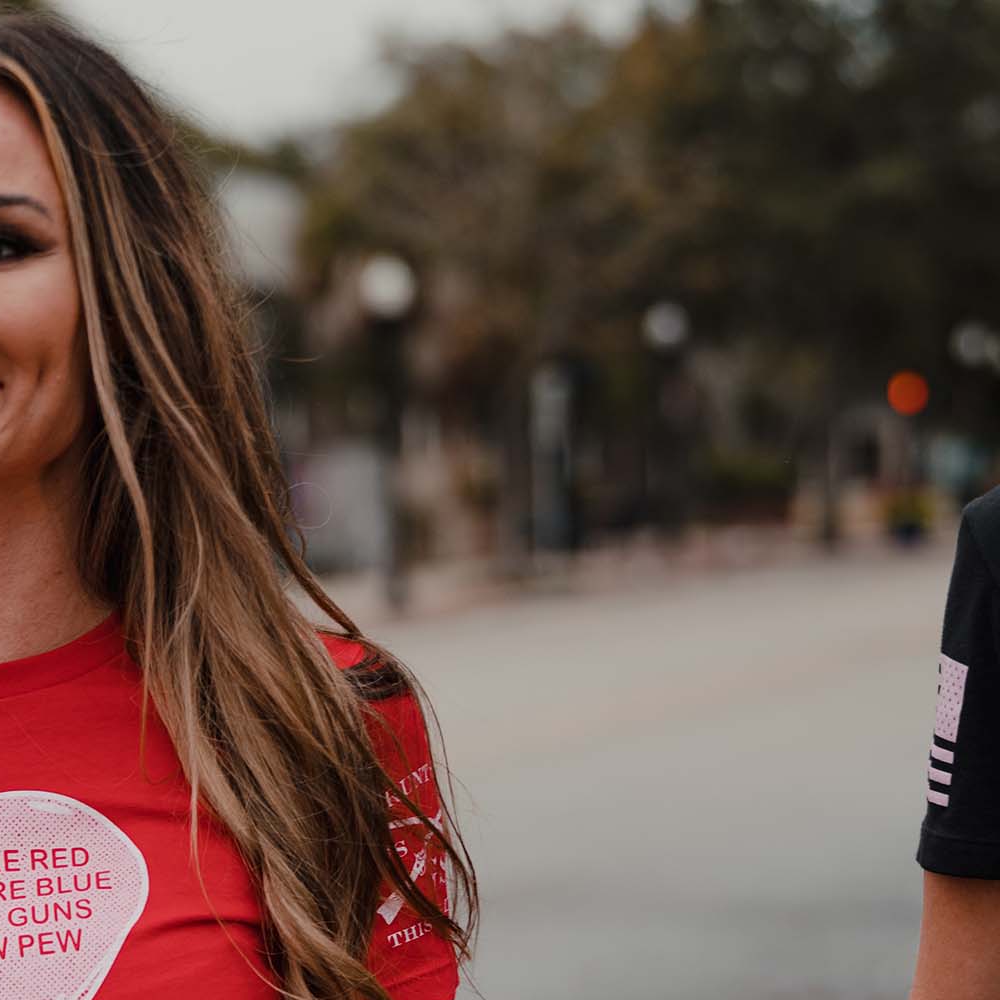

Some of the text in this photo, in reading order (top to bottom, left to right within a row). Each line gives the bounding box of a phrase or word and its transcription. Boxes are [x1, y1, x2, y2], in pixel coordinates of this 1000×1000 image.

[30, 847, 90, 871] RED
[36, 871, 113, 897] BLUE
[7, 899, 93, 927] GUNS
[18, 928, 83, 958] PEW
[387, 921, 433, 948] THIS
